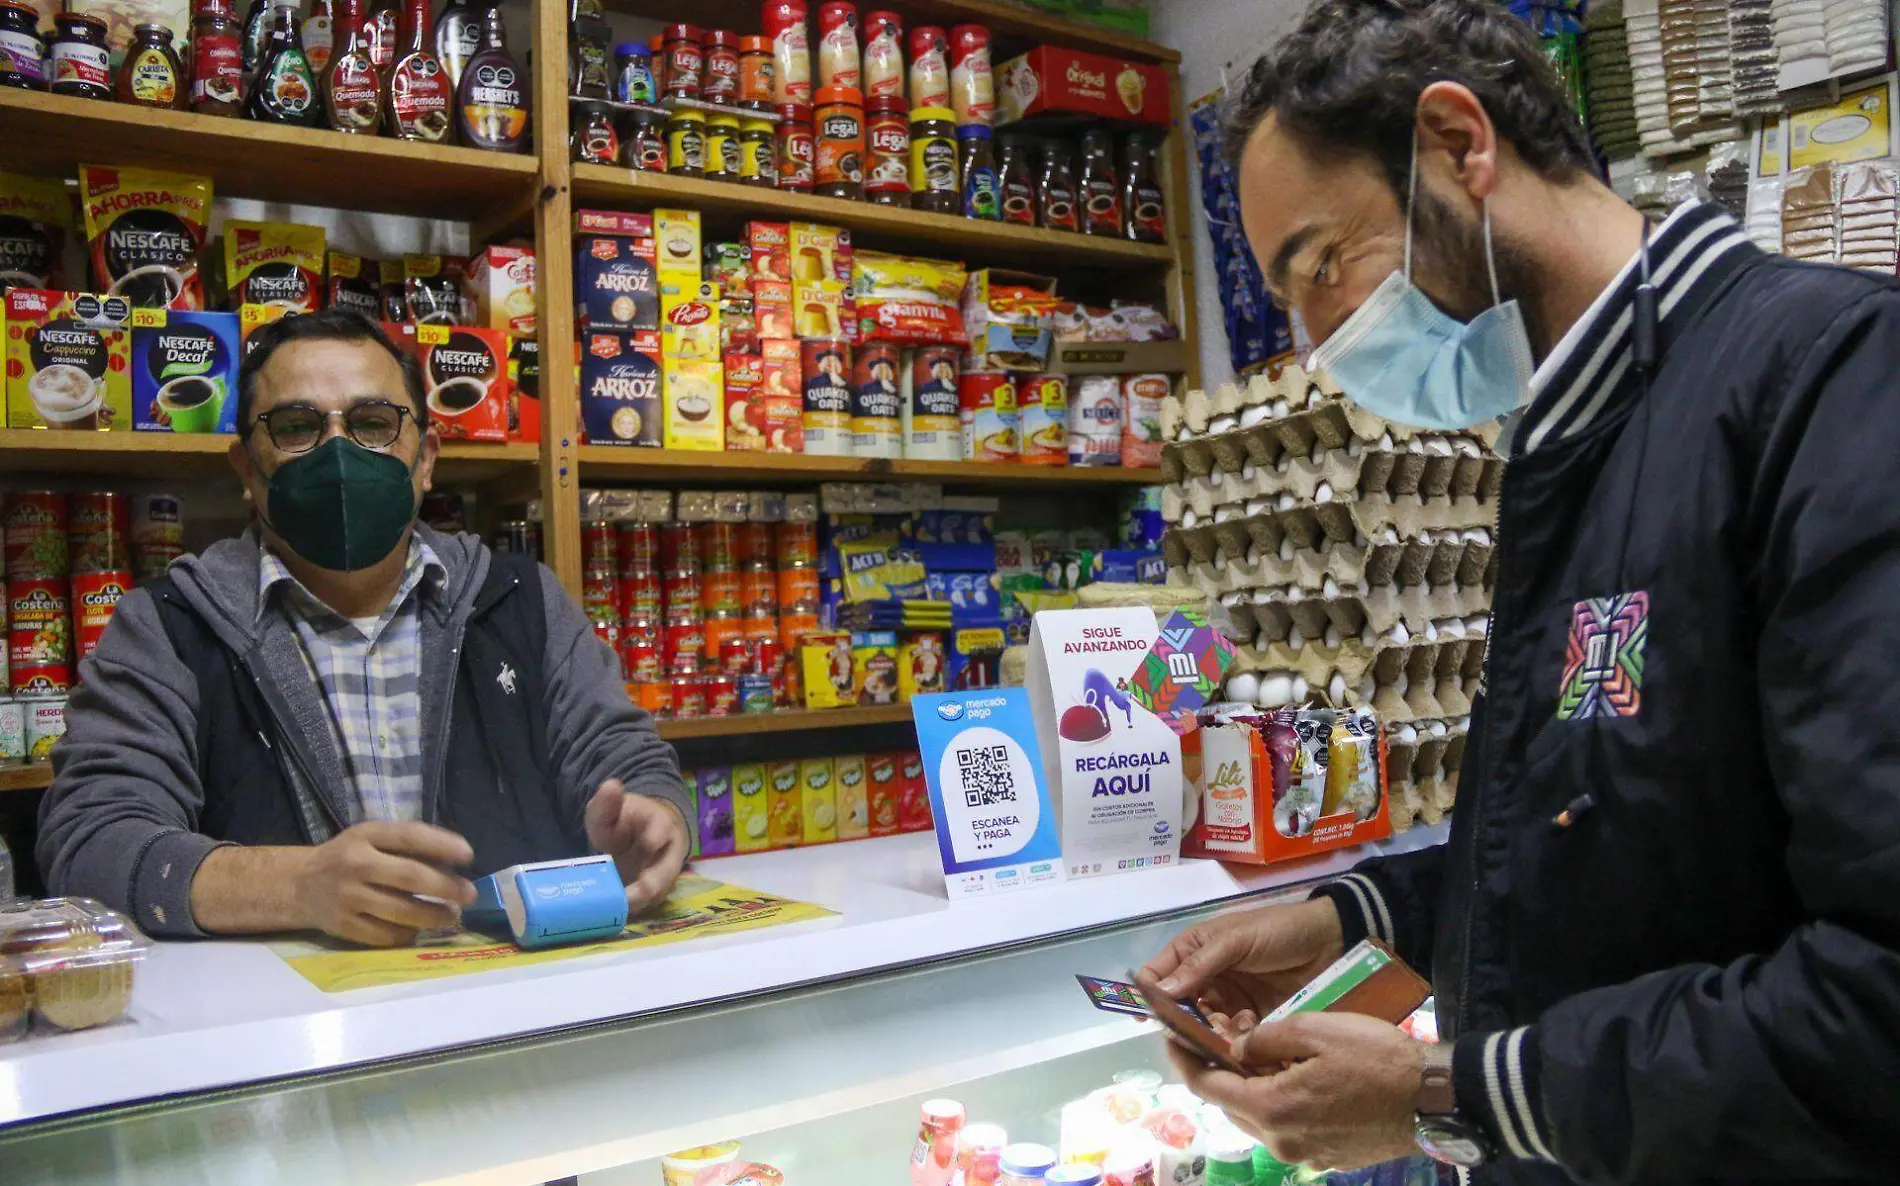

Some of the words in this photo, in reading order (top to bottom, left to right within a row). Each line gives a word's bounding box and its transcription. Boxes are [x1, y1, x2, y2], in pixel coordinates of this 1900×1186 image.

[676, 53, 701, 70] Lega
[712, 59, 739, 75] Lega
[471, 87, 520, 104] HERSHEY'S
[823, 121, 858, 138] Legal
[792, 140, 813, 161] Leg
[91, 190, 173, 219] AHORRA
[596, 273, 650, 293] ARROZ
[43, 343, 97, 356] Cappuccino
[166, 349, 210, 364] Decaf
[51, 356, 89, 365] ORIGINAL
[435, 350, 491, 367] NESCAFÉ
[590, 377, 658, 400] ARROZ
[818, 399, 845, 409] OATS
[870, 405, 895, 416] OATS
[931, 403, 955, 414] OATS
[851, 554, 875, 572] ACT
[106, 585, 119, 595] La
[1082, 627, 1122, 639] SIGUE
[1063, 639, 1147, 654] AVANZANDO
[34, 679, 47, 687] La
[965, 697, 1007, 709] mercado
[36, 708, 62, 718] HERD
[967, 708, 991, 720] pago
[1075, 751, 1170, 772] RECÁRGALA
[1091, 768, 1151, 798] AQUÍ
[972, 815, 1020, 830] ESCANEA
[974, 832, 981, 842] Y
[983, 829, 1012, 841] PAGA
